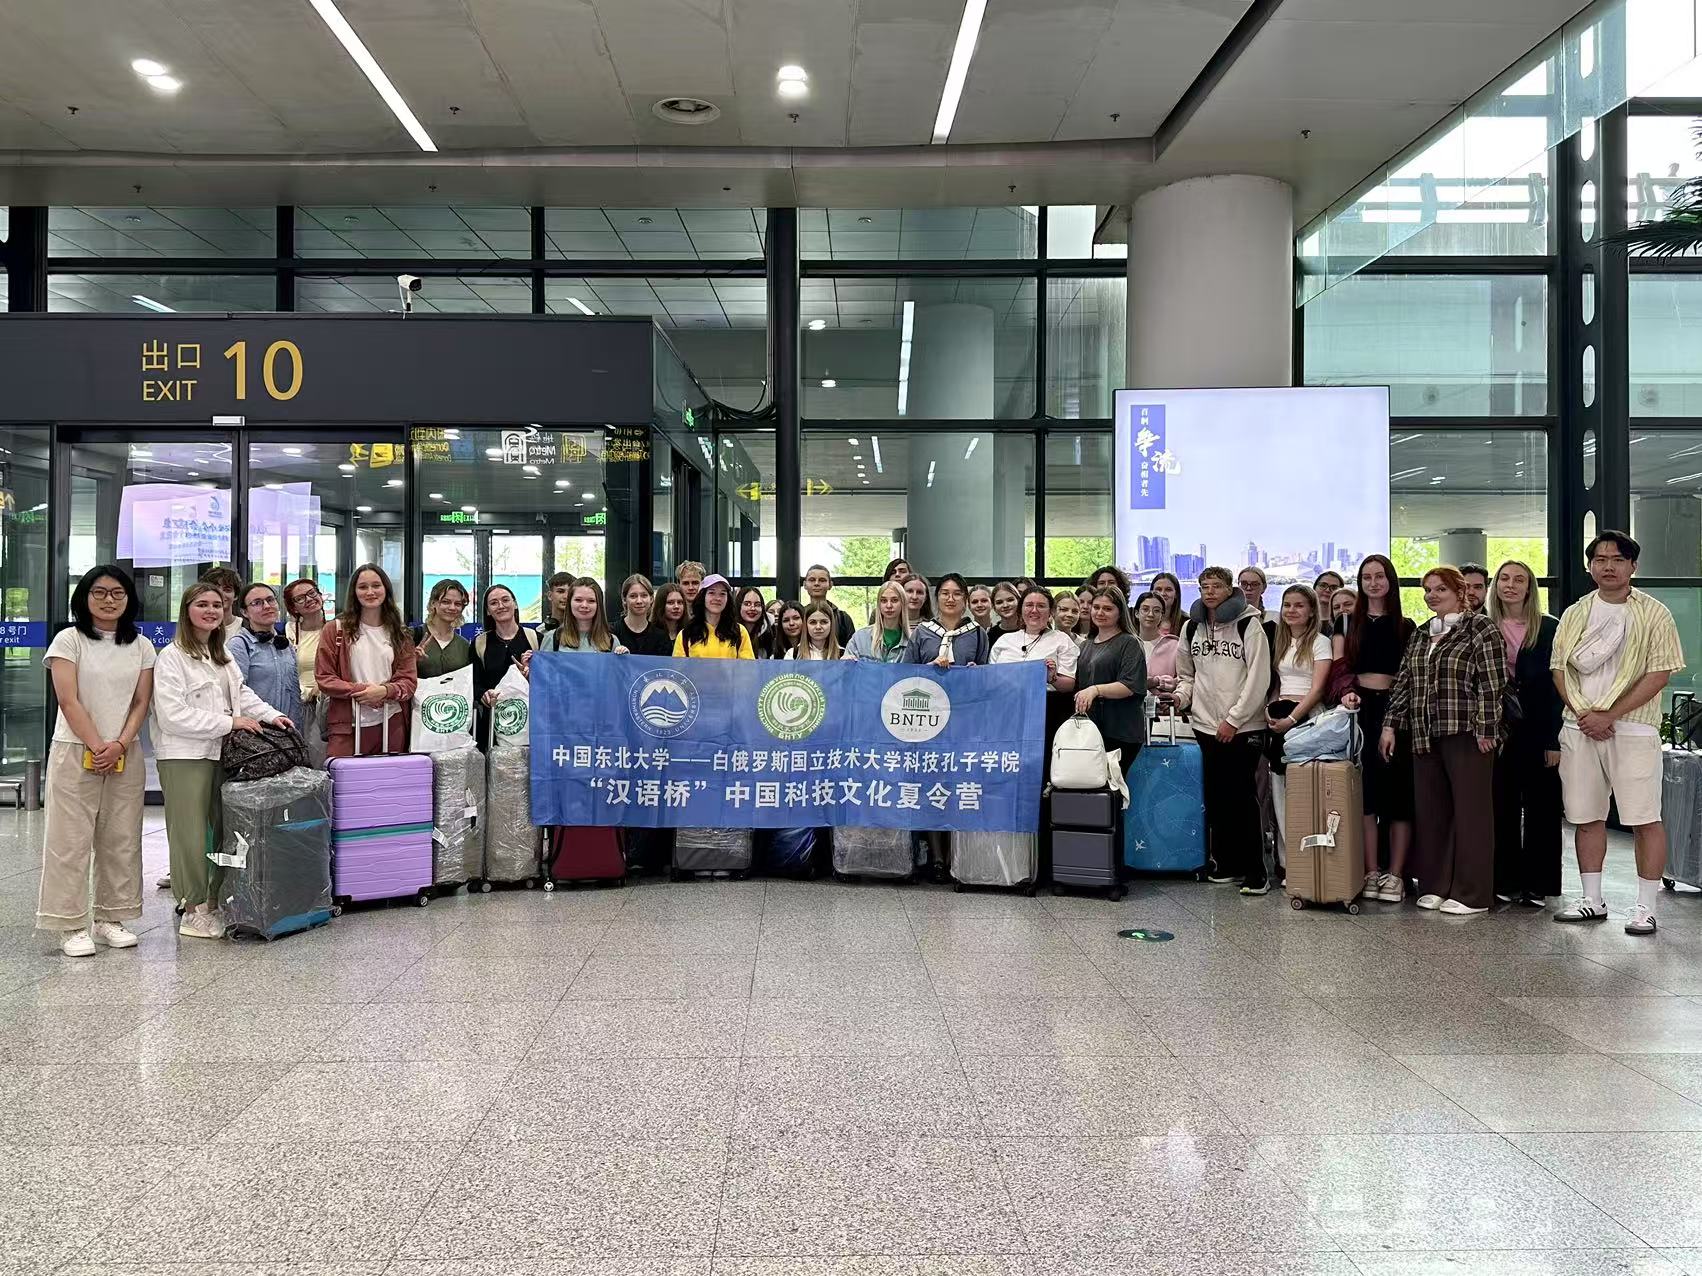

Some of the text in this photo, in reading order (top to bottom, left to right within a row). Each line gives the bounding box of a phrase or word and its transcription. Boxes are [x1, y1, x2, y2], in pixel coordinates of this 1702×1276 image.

[142, 339, 201, 371] 出口
[224, 340, 303, 401] 10
[143, 380, 198, 401] EXIT
[4, 636, 20, 644] exit
[890, 712, 940, 727] BNTU
[552, 744, 1021, 773] 中国东北大学——白俄罗斯国立技术大学科技孔子学院
[725, 778, 983, 811] 中国科技文化夏令营
